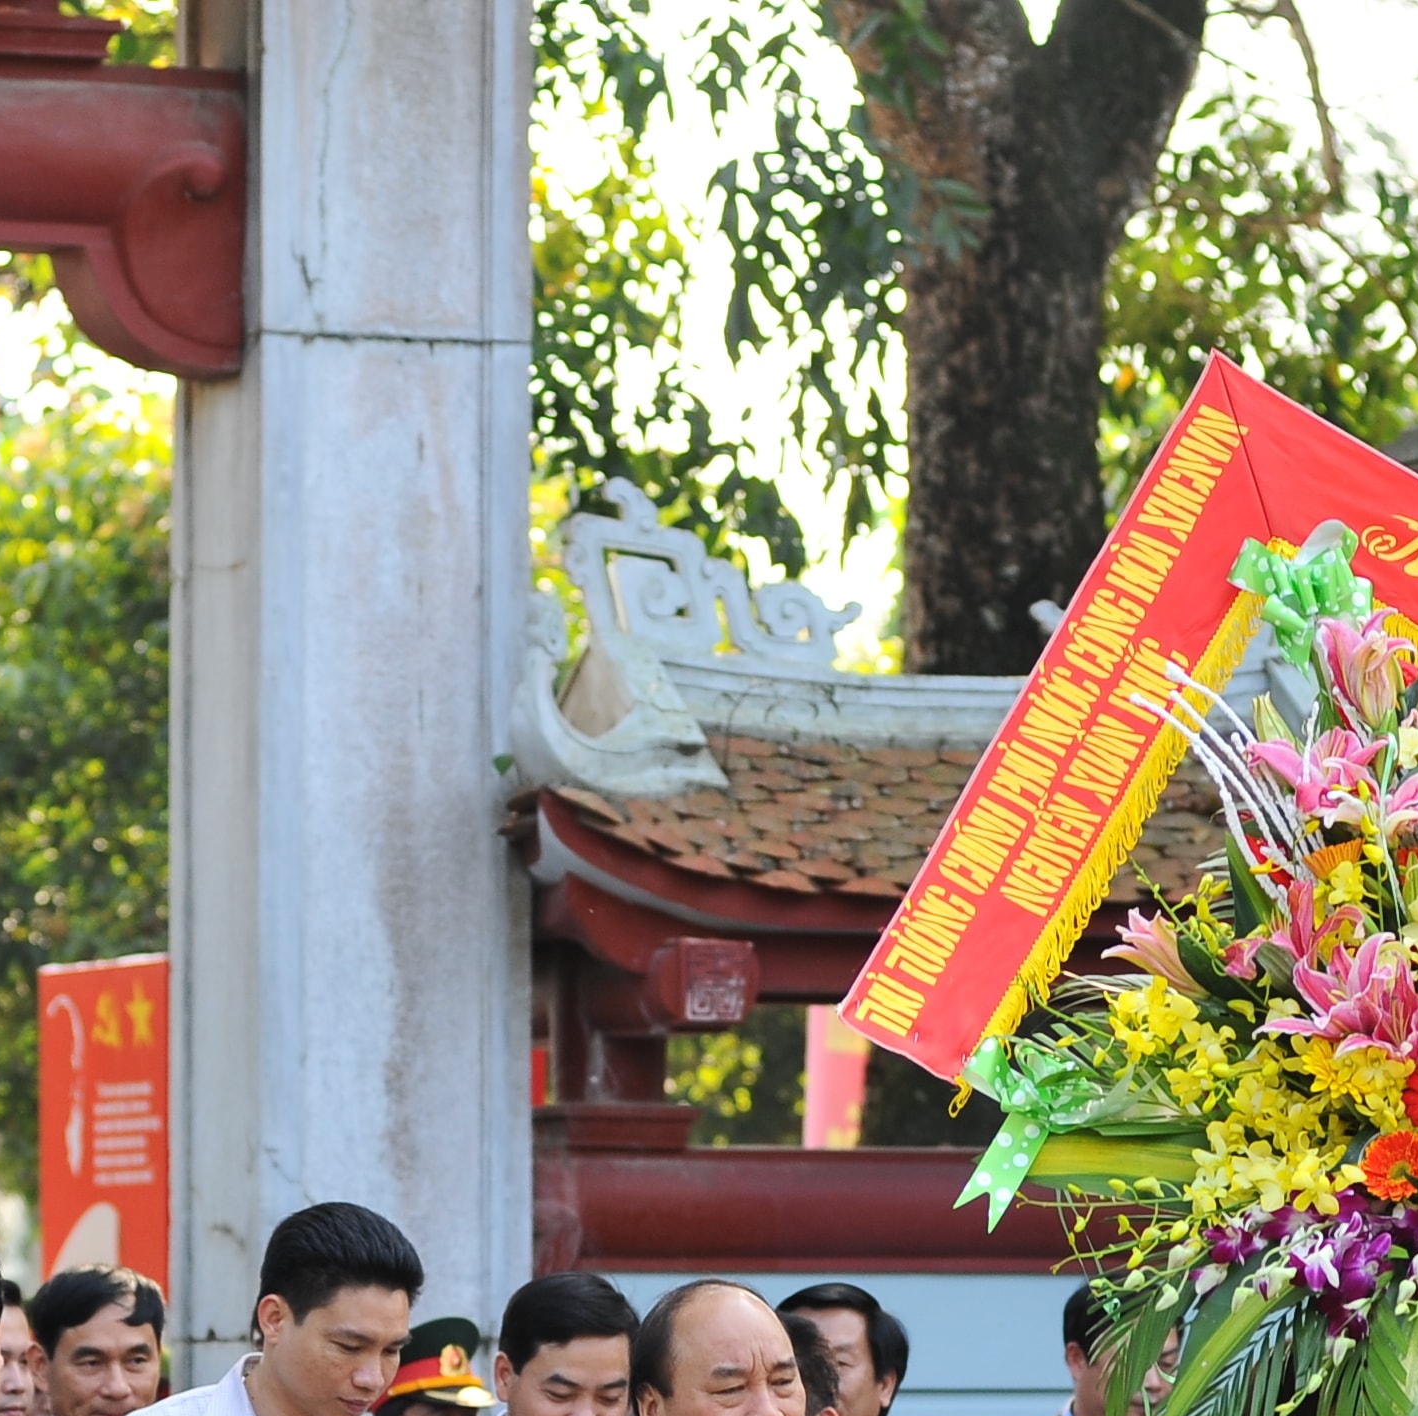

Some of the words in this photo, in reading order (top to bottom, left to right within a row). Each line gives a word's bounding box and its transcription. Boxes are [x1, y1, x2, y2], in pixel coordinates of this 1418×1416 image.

[1137, 405, 1248, 543] XHCNVN
[1106, 531, 1180, 603] HÒA
[1064, 589, 1145, 678] CỘNG
[1019, 662, 1101, 745] NƯỚC
[987, 740, 1057, 815] PHỦ
[1000, 790, 1101, 917] NGUYỄN
[1063, 714, 1145, 806] XUÂN
[1108, 638, 1189, 724] PHÚC
[939, 796, 1027, 895] CHÍNH
[885, 885, 976, 986] TƯỚNG
[855, 972, 925, 1037] THỦ
